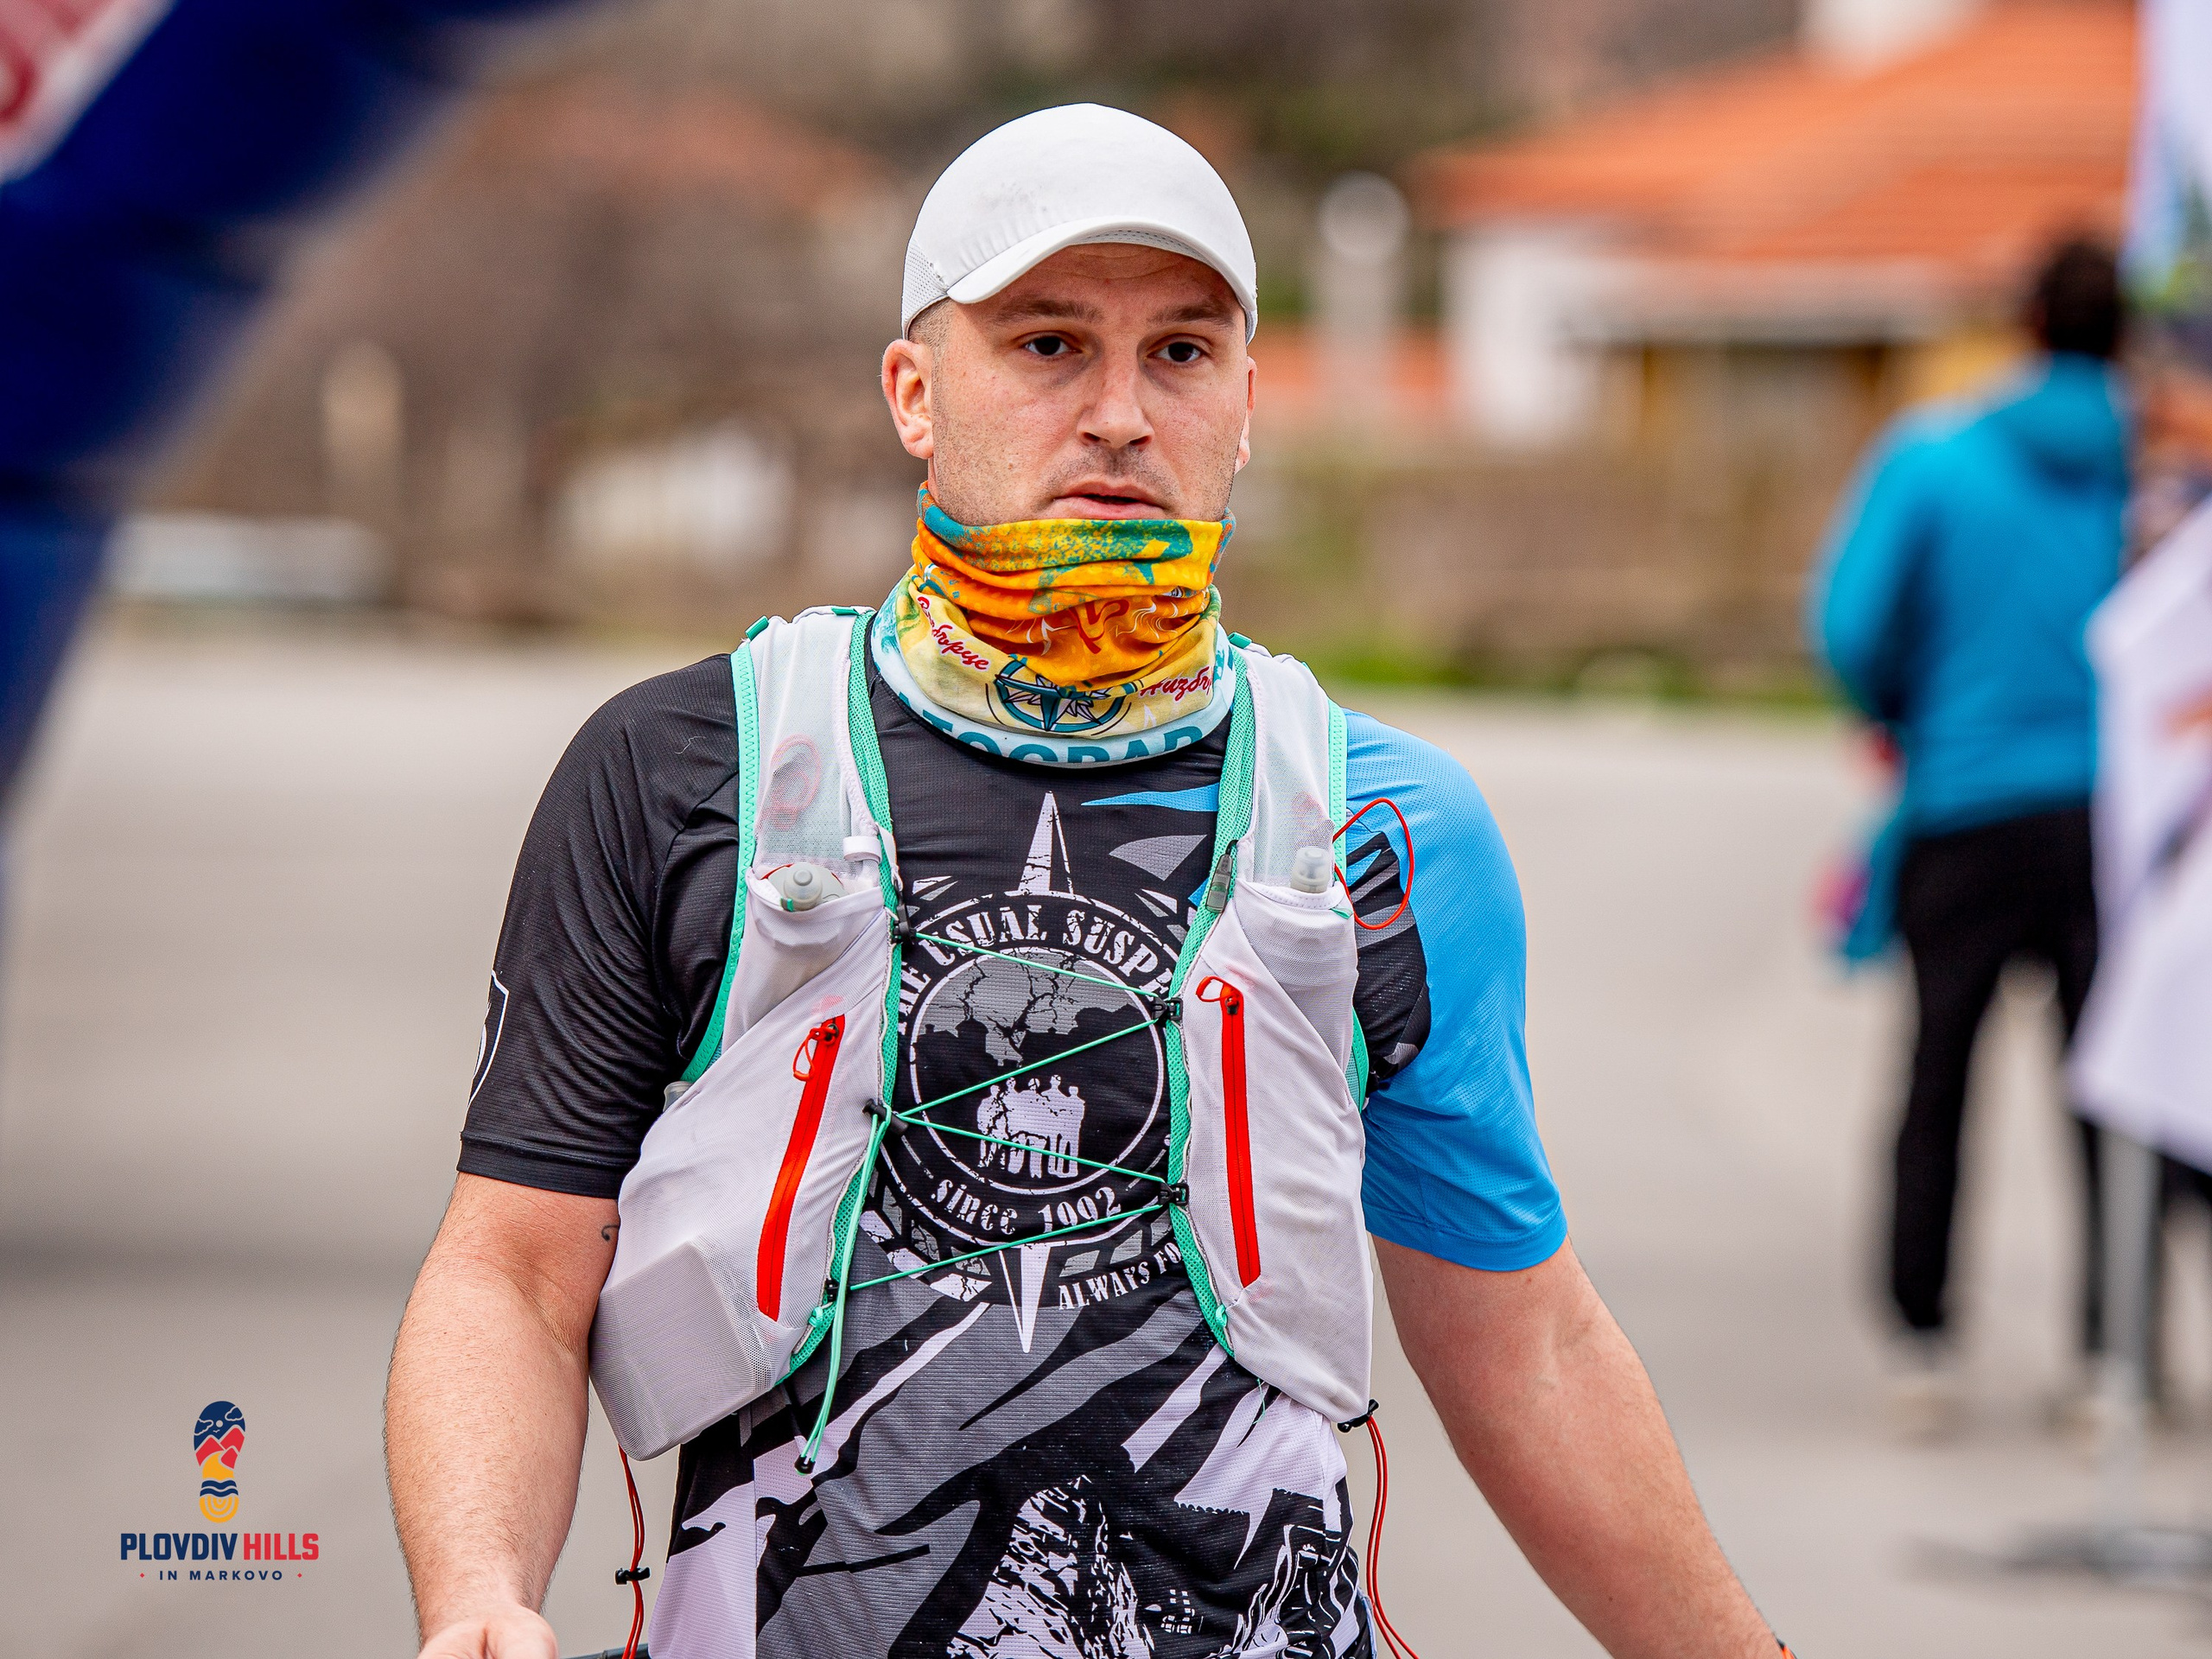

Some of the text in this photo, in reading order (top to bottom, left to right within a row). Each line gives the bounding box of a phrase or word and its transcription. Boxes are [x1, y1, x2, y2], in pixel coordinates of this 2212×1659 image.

[918, 904, 1048, 966] USUAL
[1062, 909, 1174, 1002] SUSPE
[1058, 1242, 1182, 1311] ALWAYS FO
